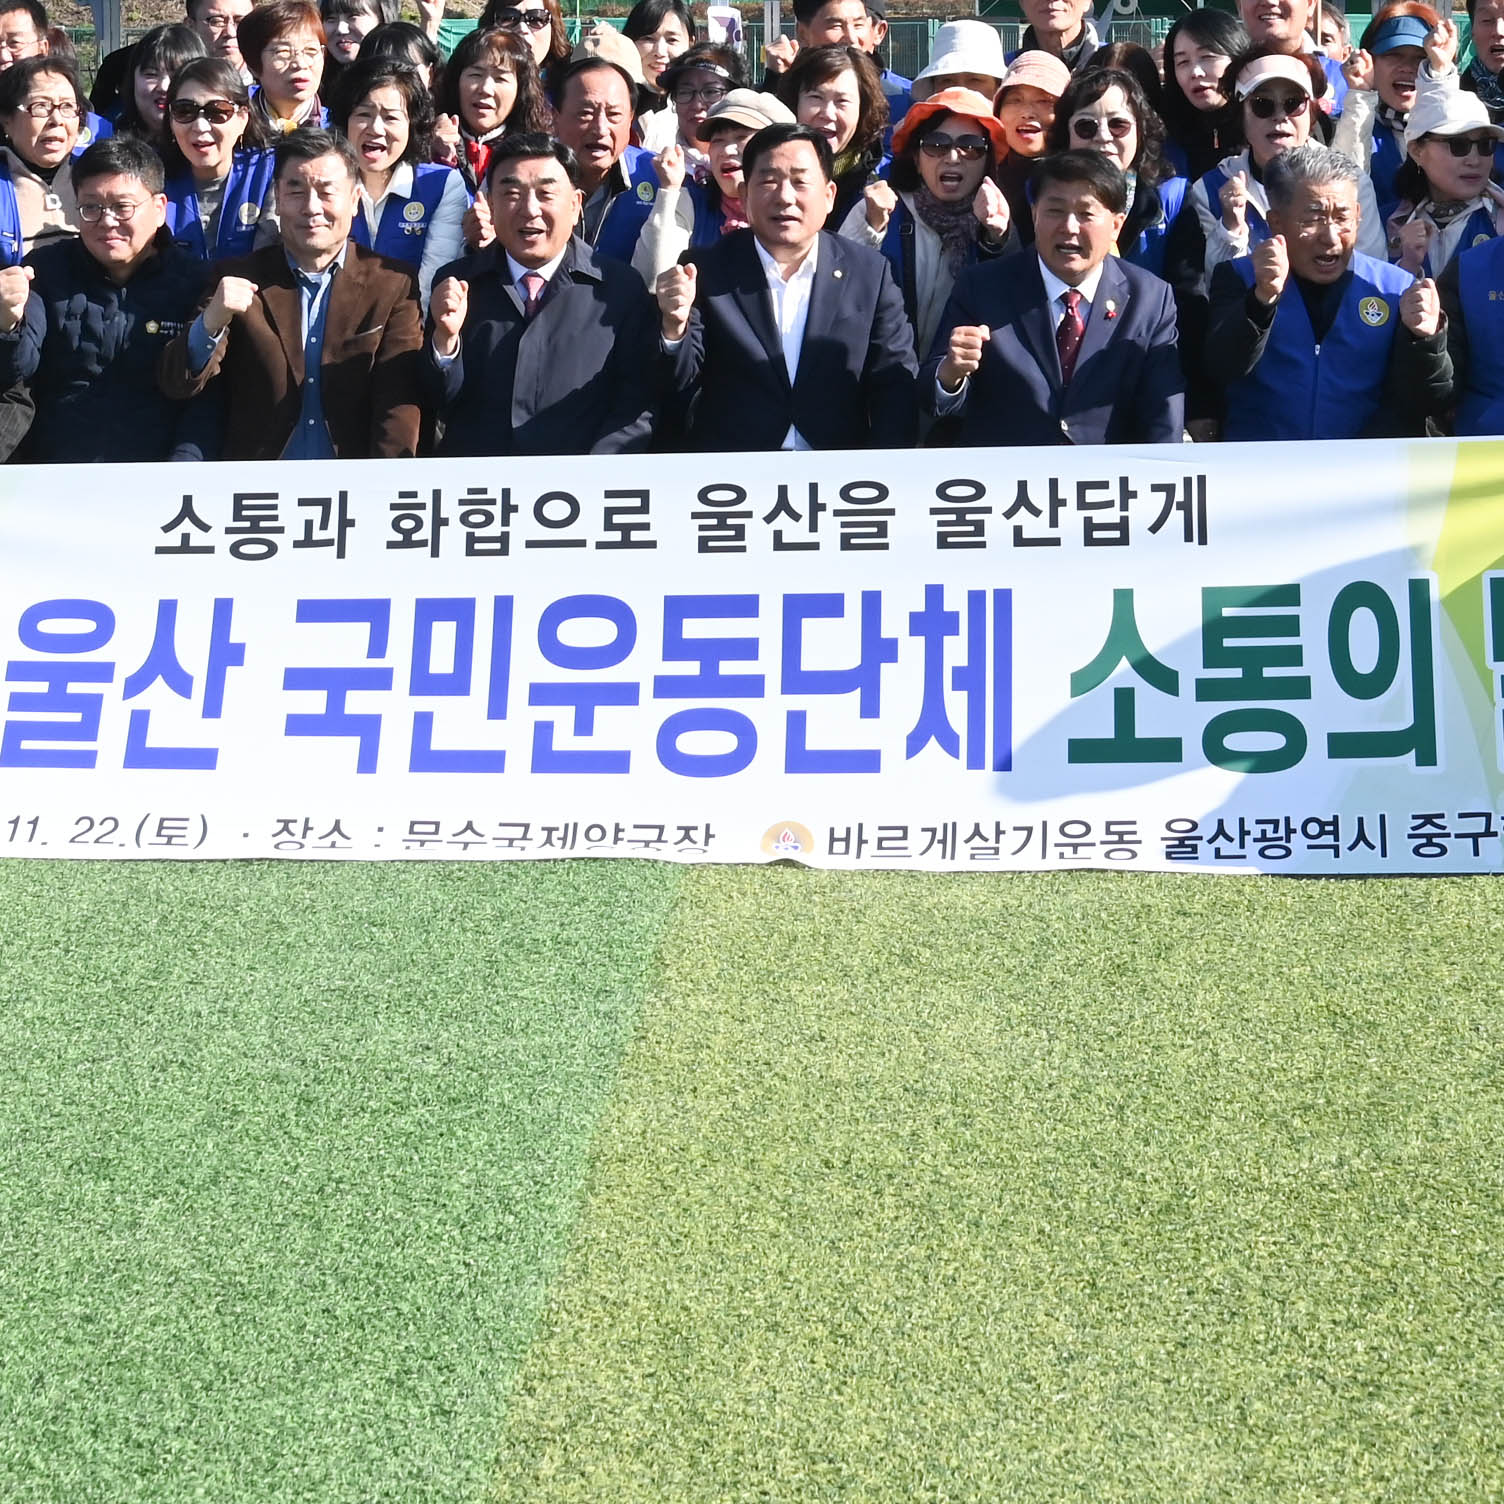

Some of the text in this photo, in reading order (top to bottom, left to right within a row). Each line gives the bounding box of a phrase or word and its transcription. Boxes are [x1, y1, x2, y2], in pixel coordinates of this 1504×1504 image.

[154, 474, 1208, 562] 소통과 화합으로 울산을 울산답게
[0, 597, 246, 770] 울산
[283, 583, 1014, 778] 국민운동단체
[1067, 578, 1438, 774] 소통의
[7, 814, 48, 846] 11.
[69, 813, 208, 850] 22.(토)
[270, 816, 353, 851] 장소
[828, 819, 1143, 861] 바르게살기운동
[1160, 813, 1389, 861] 울산광역시
